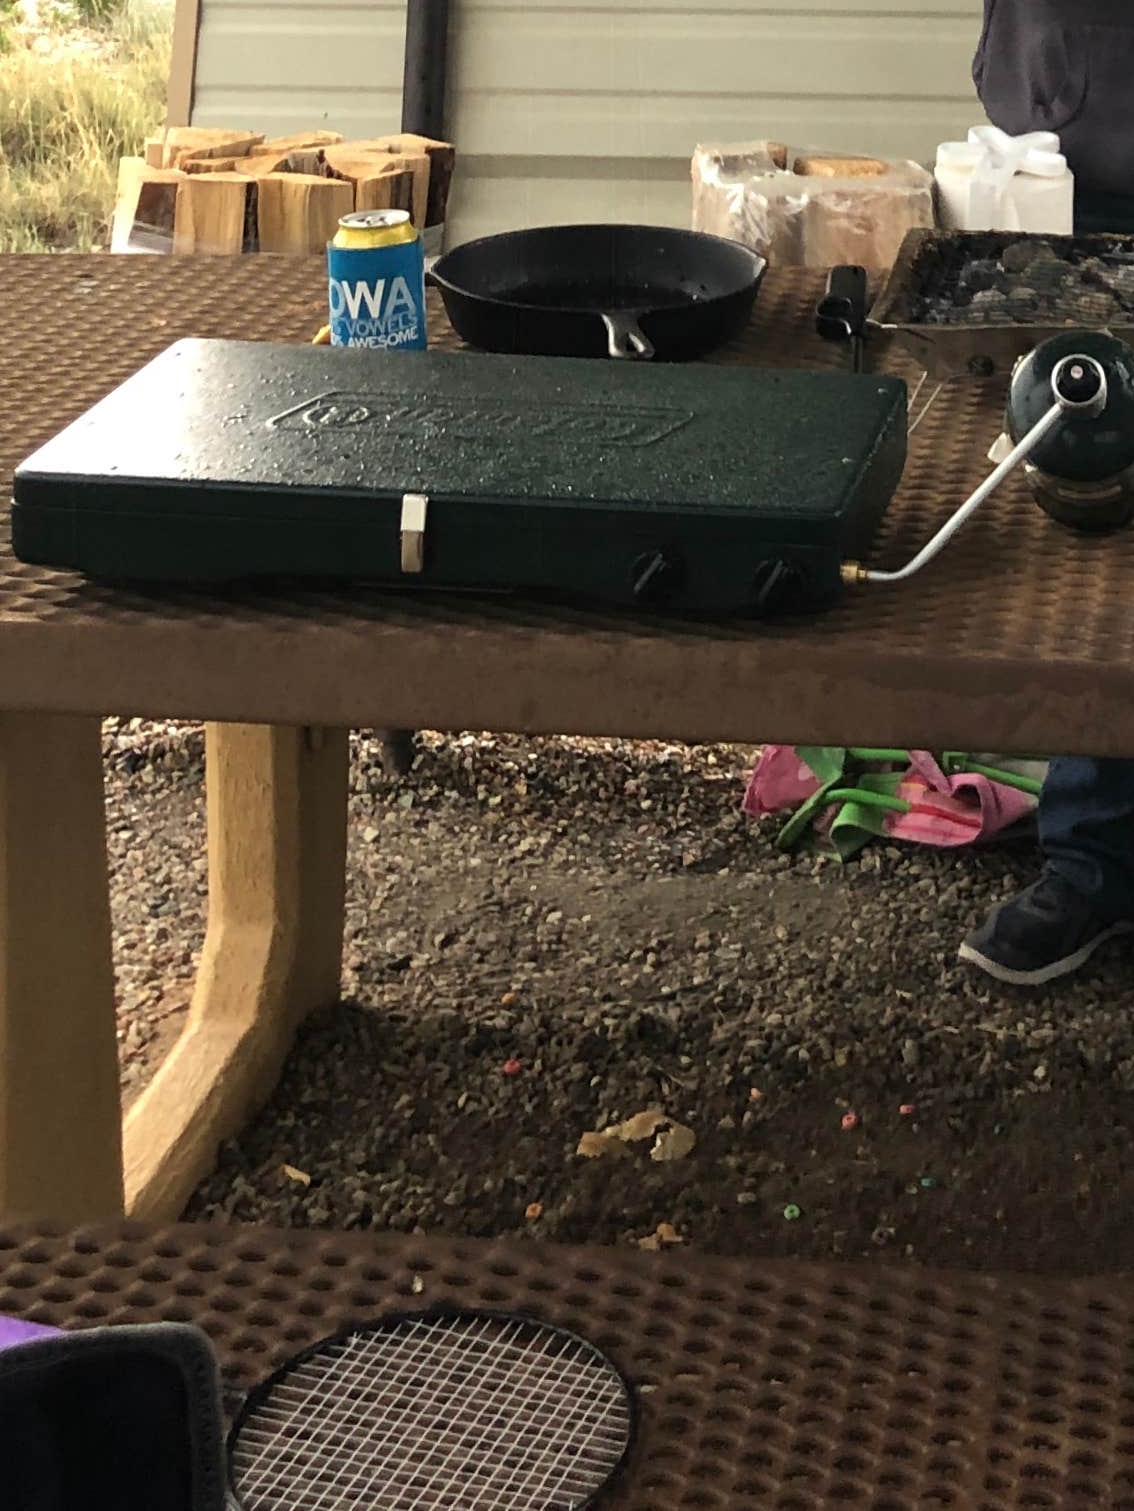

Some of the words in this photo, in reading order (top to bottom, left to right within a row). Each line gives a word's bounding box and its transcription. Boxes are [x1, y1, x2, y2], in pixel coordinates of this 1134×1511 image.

[329, 276, 416, 321] OWA
[344, 311, 418, 337] VOWELS
[348, 326, 418, 349] AWESOME
